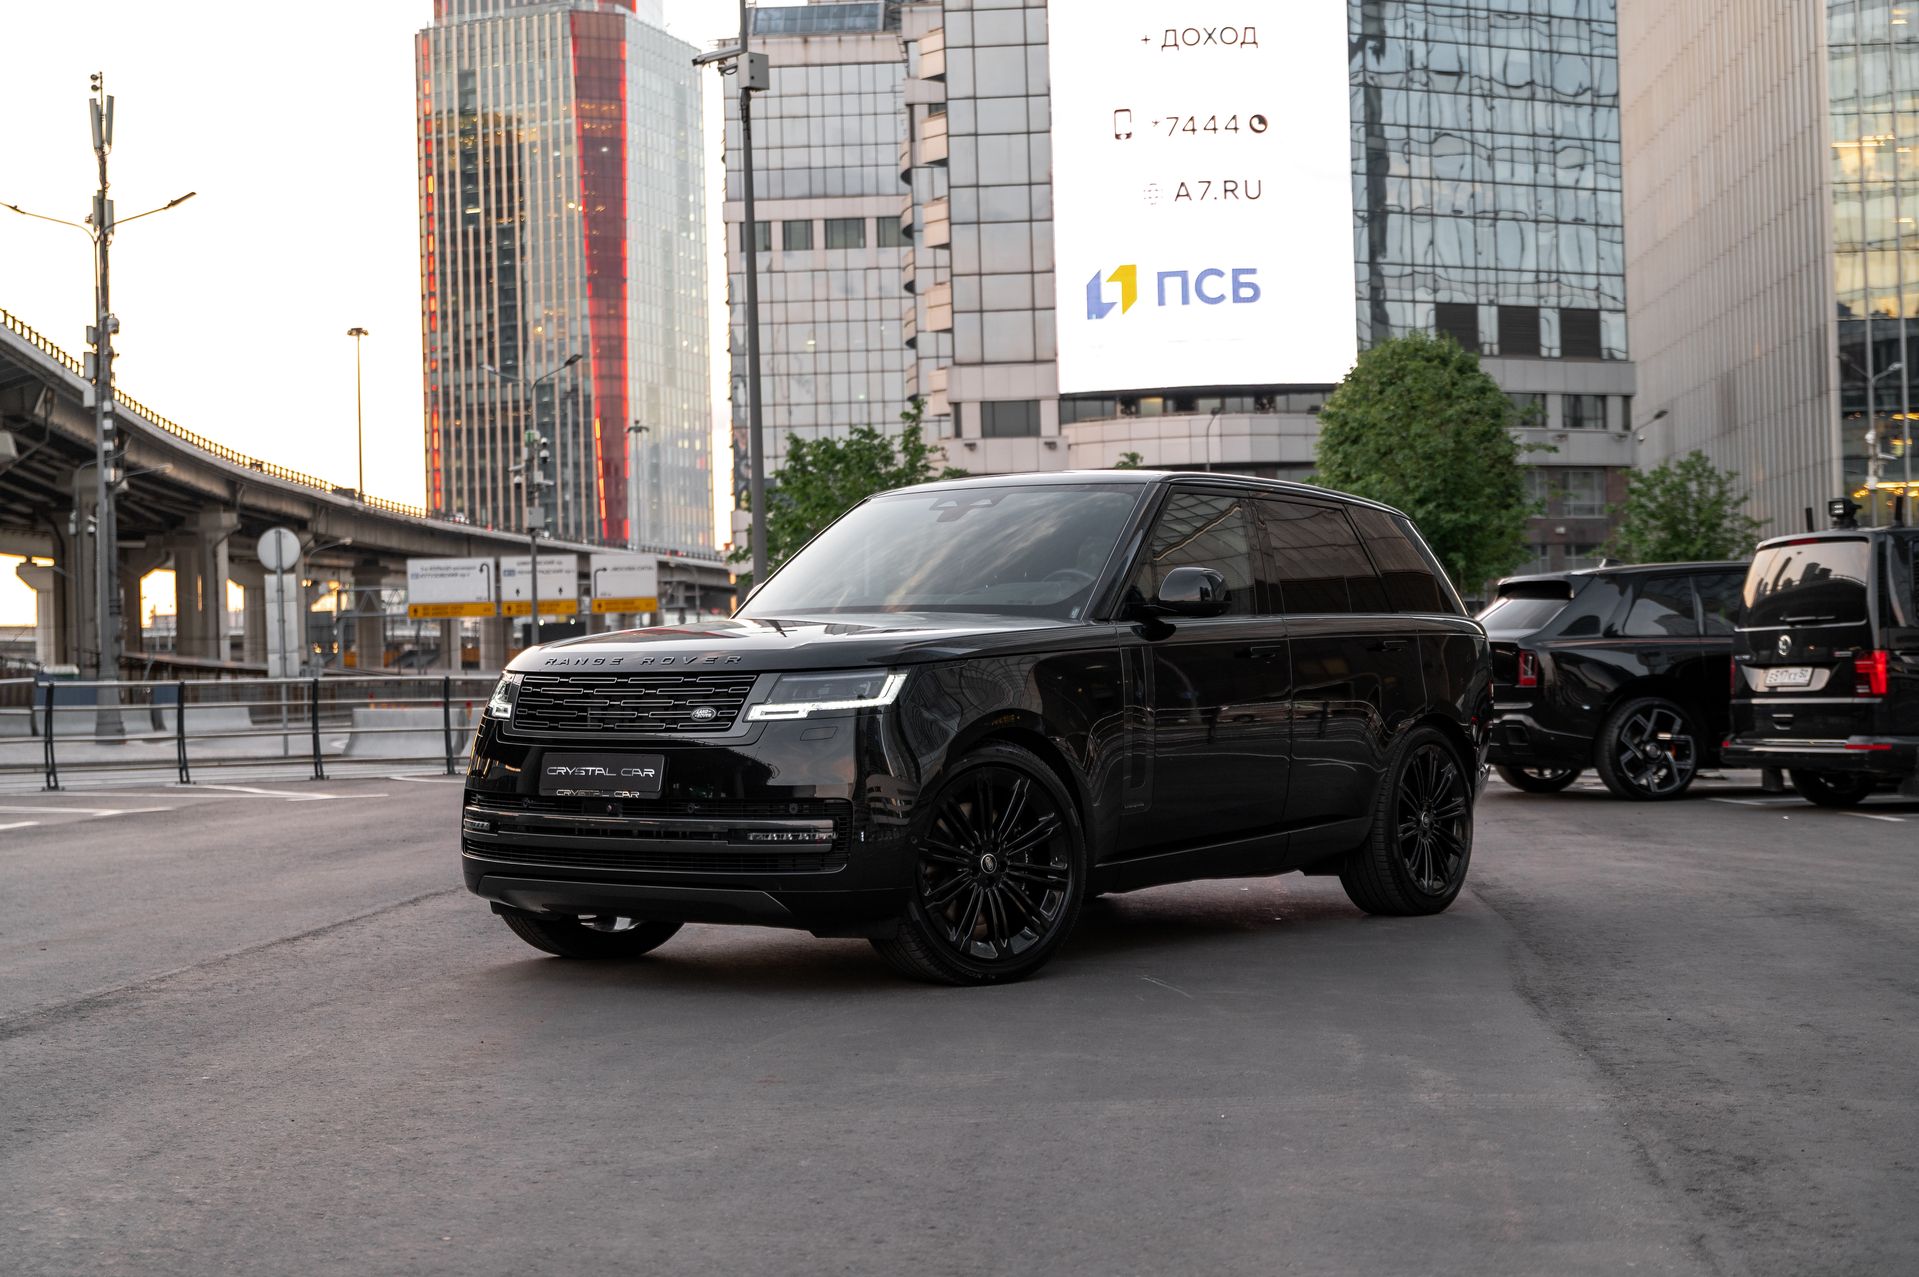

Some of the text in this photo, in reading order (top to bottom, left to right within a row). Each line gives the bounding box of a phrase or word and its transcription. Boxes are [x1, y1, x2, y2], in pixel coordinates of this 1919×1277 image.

[1160, 26, 1259, 52] ДОХОД
[1174, 179, 1262, 202] A7.RU
[1156, 267, 1262, 307] ПСБ
[544, 655, 742, 666] RANGE ROVER
[546, 766, 655, 778] CRYSTAL CAR
[556, 789, 640, 798] CRYSTAL CAR
